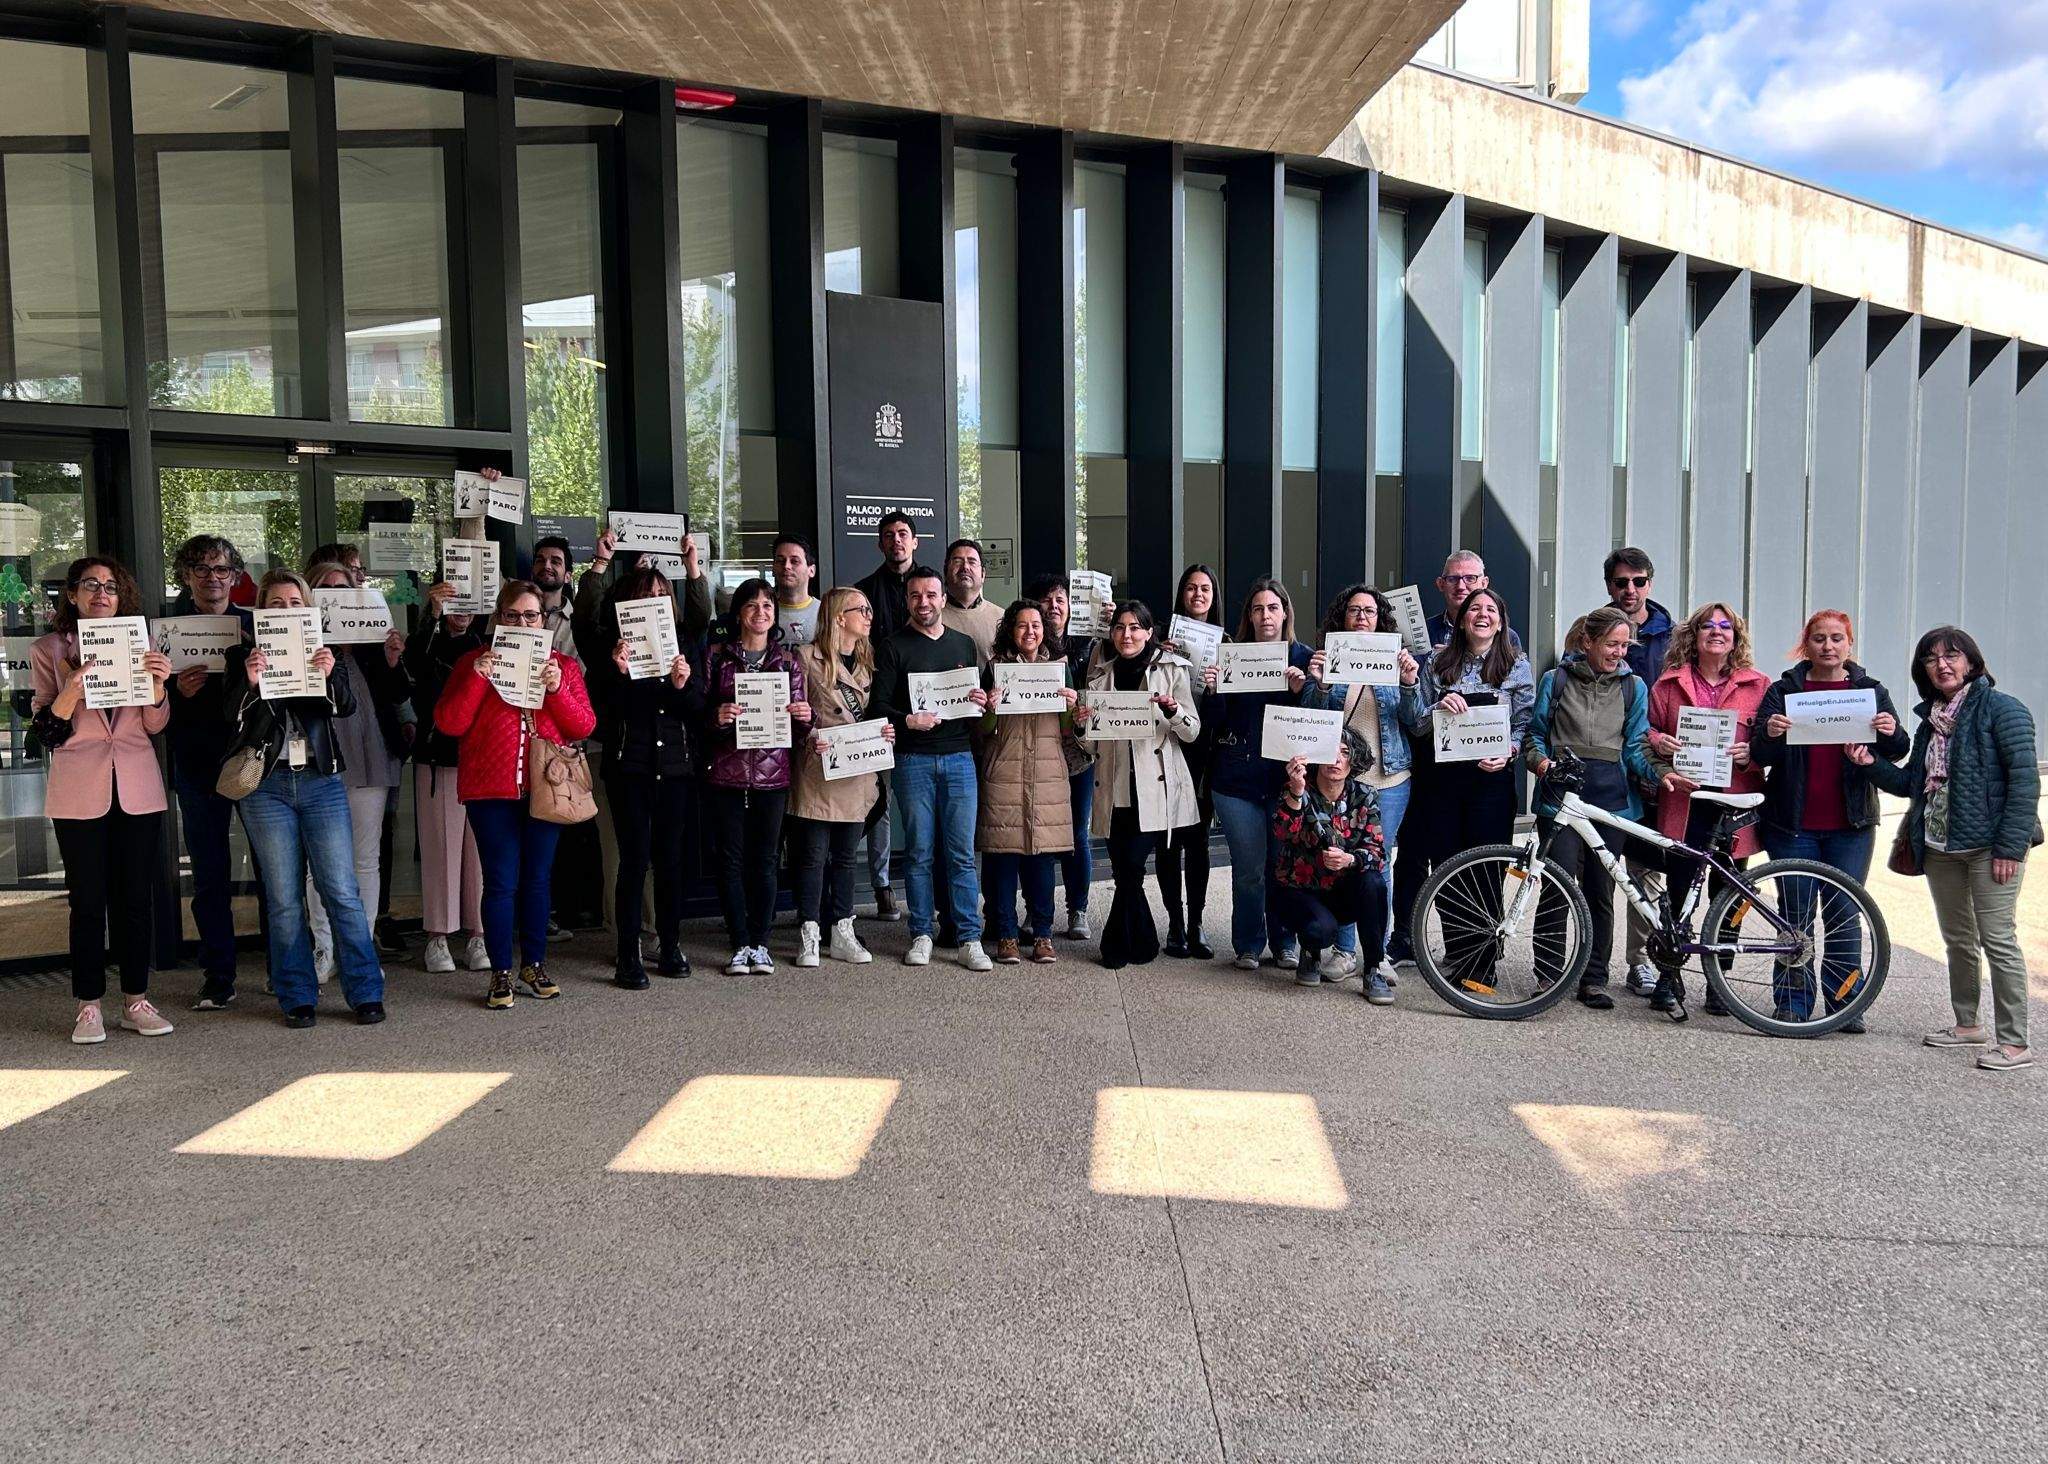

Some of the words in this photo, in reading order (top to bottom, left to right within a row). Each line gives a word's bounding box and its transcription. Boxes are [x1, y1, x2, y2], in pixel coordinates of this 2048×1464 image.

[492, 500, 517, 511] PARO
[846, 505, 882, 515] PALACIO
[885, 506, 897, 515] DE
[901, 507, 935, 518] JUSTICIA
[846, 516, 857, 526] DE
[341, 620, 356, 628] YO
[358, 620, 387, 628] PARO
[129, 629, 139, 637] NO
[257, 627, 288, 635] DIGNIDAD
[82, 637, 115, 646] DIGNIDAD
[182, 648, 199, 656] YO
[202, 648, 226, 656] PAR
[264, 649, 288, 657] STICIA
[83, 653, 97, 661] POR
[1349, 662, 1363, 670] YO
[1366, 662, 1393, 671] PARO
[85, 674, 99, 682] POR
[86, 680, 118, 689] IGUALDAD
[950, 697, 970, 705] PAR
[1796, 697, 1867, 707] #HuelgaEnJusticia
[1108, 719, 1121, 727] YO
[1273, 715, 1335, 726] #HuelgaEnJusticia
[1828, 715, 1851, 723] PARO
[1298, 735, 1318, 743] PARO
[1460, 737, 1474, 745] YO
[1476, 735, 1504, 744] PARO
[846, 753, 860, 761] YO
[862, 748, 887, 758] PARO
